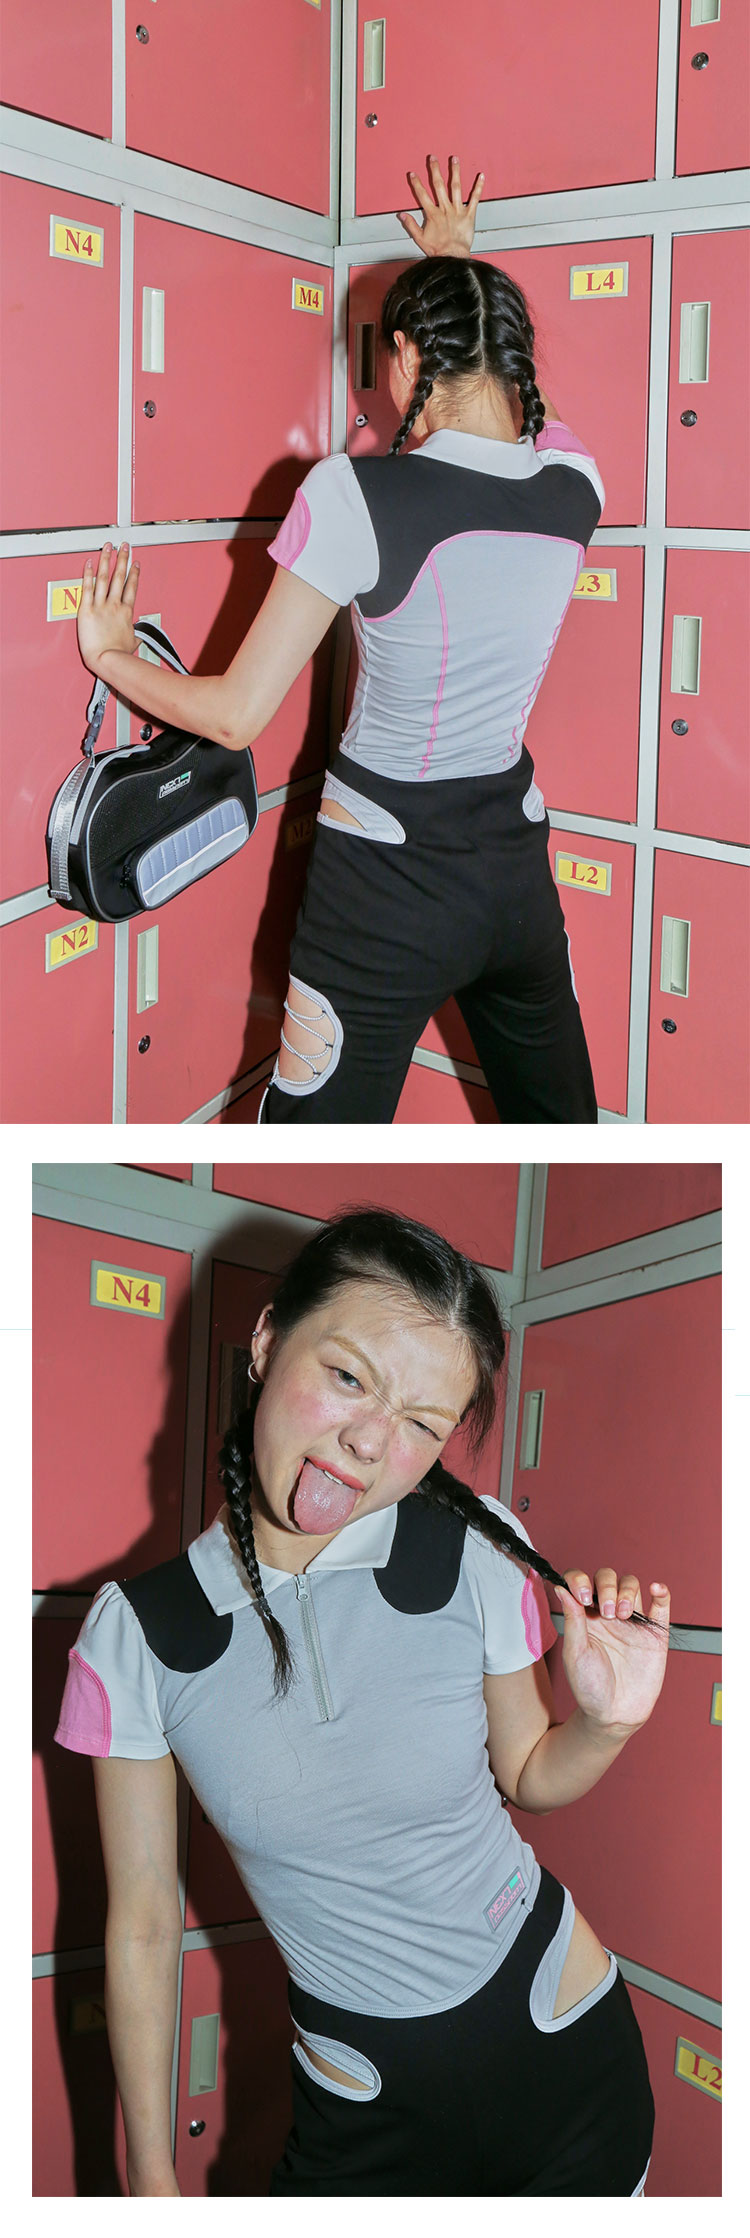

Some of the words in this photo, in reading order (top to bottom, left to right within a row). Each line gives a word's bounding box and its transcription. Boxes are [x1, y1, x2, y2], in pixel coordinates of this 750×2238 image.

[65, 229, 94, 256] N4
[586, 271, 615, 291] L4
[299, 287, 319, 308] M4
[290, 820, 312, 842] M2
[570, 861, 599, 885] L2
[61, 925, 89, 956] N2
[112, 1276, 151, 1307] N4
[691, 2053, 722, 2090] L2
